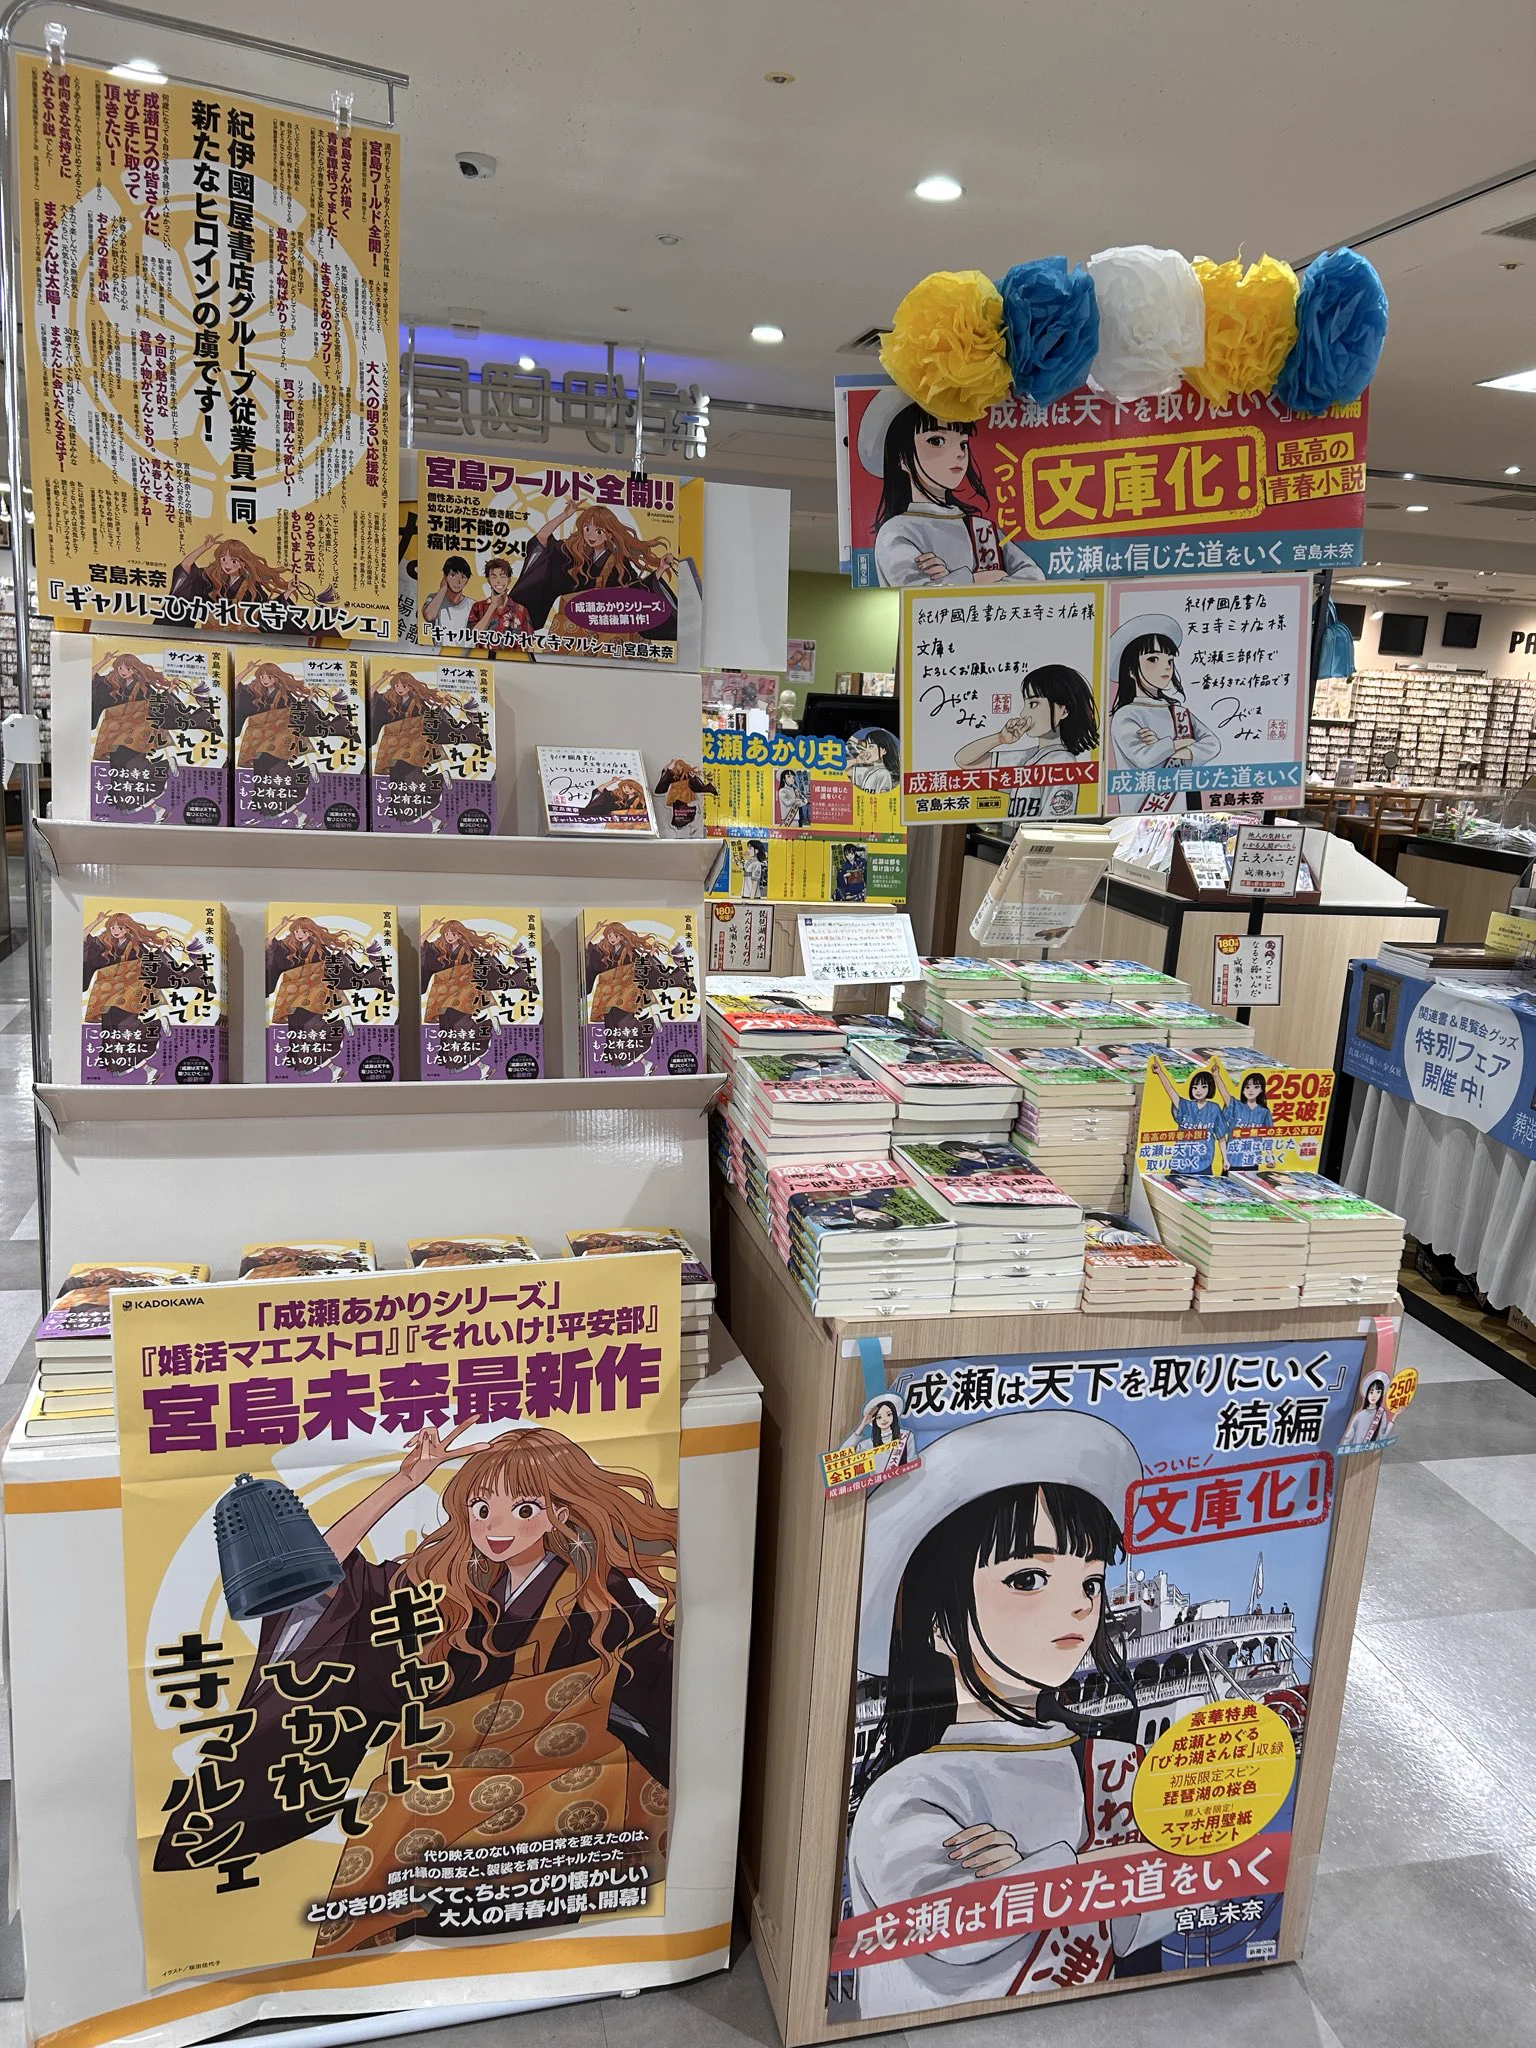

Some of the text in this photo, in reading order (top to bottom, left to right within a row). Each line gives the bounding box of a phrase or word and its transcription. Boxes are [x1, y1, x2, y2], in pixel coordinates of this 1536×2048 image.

[58, 73, 72, 179] 前向きな気持ちに
[103, 82, 120, 166] 頂きたい！
[123, 88, 140, 199] ぜひ手に取って
[143, 92, 160, 237] 成瀬ロスの皆さんに
[341, 136, 352, 220] 宮島さんが描く
[327, 132, 338, 249] 青春譚待ってました！
[368, 140, 382, 267] 宮島ワールド全開！
[43, 201, 61, 320] まみたんは太陽！
[97, 212, 110, 304] おとなの青春小説
[191, 99, 221, 441] 新たなヒロインの虜です！
[276, 227, 289, 371] 最高な人物ばかりなのでしょうか。
[227, 107, 258, 535] 紀伊國屋書店グループ従業員一同、
[139, 330, 156, 453] 登場人物がてんこもり。
[154, 332, 169, 418] 今回も魅力的な
[50, 325, 67, 473] まみたんに会いたくなるはず！
[283, 378, 295, 497] 買って即読んで欲しい！
[365, 360, 380, 488] 大人への明るい応援歌
[1281, 439, 1349, 467] 最高の
[138, 456, 153, 528] いいんですね！
[151, 457, 163, 501] 青春して
[163, 459, 176, 524] 大人も全力で
[425, 456, 675, 511] 宮島ワールド全開！！
[994, 463, 1018, 529] ついに
[1037, 445, 1252, 525] 文庫化！
[1268, 467, 1365, 502] 青春小説
[427, 492, 480, 506] 個性あふれる
[427, 504, 531, 521] 幼なじみたちが巻き起こす
[304, 511, 316, 573] めっちゃ元気
[427, 515, 510, 537] 予測不能の
[291, 510, 302, 585] もらいました！
[427, 534, 528, 557] 痛快エンタメ！
[1048, 540, 1283, 575] 成瀬は信じた道をいく
[1292, 543, 1354, 561] 宮島未奈
[88, 563, 167, 588] 宮島未奈
[49, 580, 389, 638] 『ギャルにひかれて寺マルシェ』
[351, 602, 390, 610] KADOKAWA
[569, 599, 667, 613] 「成瀬あかりシリーズ」
[588, 613, 651, 626] 完結後第1作！
[423, 622, 623, 657] 『ギャルにひかれて寺マルシェ』
[624, 642, 674, 659] 宮島未奈
[916, 638, 956, 658] 文庫も
[1191, 648, 1279, 665] 成瀬三部作で
[168, 652, 205, 664] サイン本
[211, 651, 221, 688] 宮島未奈
[307, 661, 343, 672] サイン本
[349, 660, 358, 697] 宮島未奈
[1191, 673, 1291, 690] 一番好きな作品です
[146, 693, 168, 779] 寺マルシェ
[174, 699, 197, 765] ひかれて
[201, 695, 221, 760] ギャルに
[287, 702, 309, 785] 寺マルシェ
[314, 708, 335, 771] ひかれて
[340, 703, 360, 767] ギャルに
[94, 764, 150, 779] 「このお寺を
[94, 781, 156, 794] もっと有名に
[238, 772, 292, 786] 「このお寺を
[909, 763, 1096, 793] 成瀬は天下を取りにいく
[1111, 765, 1298, 793] 成瀬は信じた道をいく
[94, 794, 145, 806] したいの！」
[239, 787, 297, 799] もっと有名に
[239, 799, 288, 812] したいの！」
[916, 797, 970, 812] 宮島未奈
[1209, 792, 1264, 807] 宮島未奈
[205, 907, 215, 945] 宮島未奈
[684, 915, 692, 948] 宮島未奈
[139, 951, 162, 1038] 寺マルシェ
[168, 960, 190, 1023] ひかれて
[194, 953, 215, 1018] ギャルに
[633, 954, 653, 1035] 寺マルシェ
[656, 963, 675, 1020] ひかれて
[679, 955, 695, 1015] ギャルに
[85, 1028, 142, 1040] 「このお寺を
[591, 1027, 638, 1037] 「このお寺を
[592, 1039, 644, 1050] もっと有名に
[1418, 1005, 1519, 1051] 関連書＆展覧会グッズ
[85, 1055, 137, 1067] したいの！」
[86, 1041, 148, 1053] もっと有名に
[593, 1051, 637, 1062] したいの！」
[1415, 1026, 1511, 1079] 特別フェア
[1266, 1074, 1320, 1100] 250
[1319, 1074, 1334, 1098] 万部
[1422, 1061, 1485, 1108] 開催中！
[1272, 1101, 1326, 1123] 突破！
[1141, 1130, 1207, 1142] 最高の青春小説！
[1227, 1138, 1296, 1155] 成瀬は信じた
[1232, 1126, 1322, 1138] 唯一無二の主人公再び！
[1139, 1143, 1207, 1158] 成瀬は天下を
[1146, 1158, 1200, 1171] 取りにいく
[1243, 1154, 1285, 1166] 道をいく
[1299, 1147, 1317, 1156] 続編
[828, 1161, 899, 1178] 180
[135, 1297, 204, 1309] KADOKAWA
[257, 1281, 561, 1332] 「成瀬あかりシリーズ」
[142, 1305, 658, 1377] 『婚活マエストロ』『それいけ！平安部』
[142, 1342, 662, 1454] 宮島未奈最新作
[896, 1353, 1347, 1415] 『成瀬は天下を取りにいく』
[1388, 1380, 1412, 1399] 250
[1215, 1396, 1325, 1450] 続編
[824, 1448, 855, 1462] 読み応え
[826, 1440, 899, 1471] ますますパワーアップの
[1154, 1455, 1199, 1472] ついに
[829, 1460, 874, 1485] 全5篇！
[829, 1468, 900, 1498] 成瀬は信じた道をいく
[1135, 1464, 1322, 1541] 文庫化！
[371, 1580, 453, 1797] ギャルに
[1191, 1704, 1258, 1727] 豪華特典
[261, 1657, 371, 1837] ひかれて
[1172, 1727, 1259, 1751] 成瀬とめぐる
[152, 1631, 262, 1894] 寺マルシェ
[1150, 1741, 1284, 1772] 「びわ湖さんぽ」収録
[1163, 1780, 1257, 1806] 琵琶湖の桜色
[1171, 1766, 1260, 1788] 初版限定スピン
[1161, 1809, 1253, 1834] スマホ用壁紙
[1184, 1803, 1234, 1818] 購入者限定！
[423, 1831, 650, 1863] 代り映えのない俺の日常を変えたのは、
[1170, 1827, 1239, 1848] プレゼント
[387, 1849, 625, 1885] 腐れ縁の悪友と、袈裟を着たギャルだった
[307, 1865, 649, 1923] とびきり楽しくて、ちょっぴり懐かしい
[439, 1887, 648, 1928] 大人の青春小説、開幕！
[848, 1846, 1273, 1959] 成瀬は信じた道をいく
[1175, 1899, 1264, 1933] 宮島未奈
